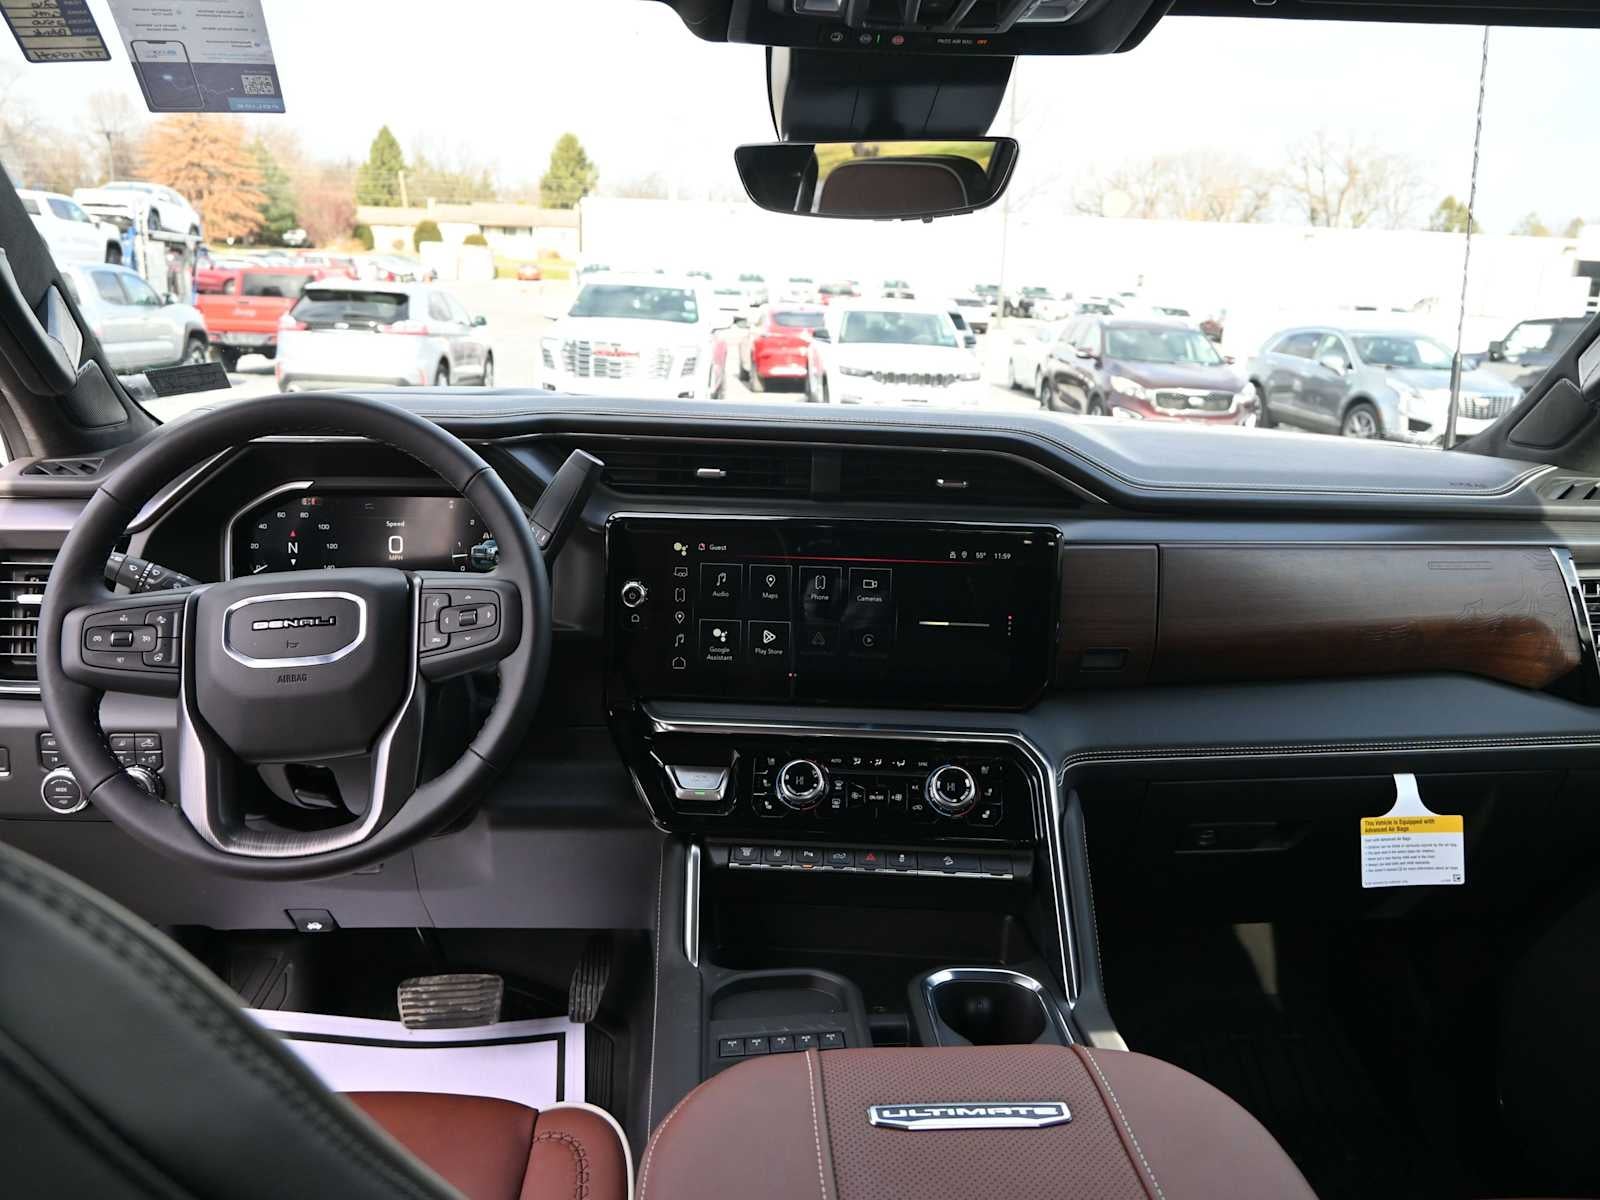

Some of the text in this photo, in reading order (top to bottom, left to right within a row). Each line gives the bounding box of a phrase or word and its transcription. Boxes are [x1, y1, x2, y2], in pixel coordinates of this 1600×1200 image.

[386, 520, 405, 528] Speed
[287, 541, 299, 554] N
[709, 543, 727, 551] Guest
[712, 590, 730, 598] Audio
[762, 592, 779, 600] Maps
[856, 595, 883, 603] Cameras
[252, 616, 336, 631] DENALI
[709, 646, 731, 654] Google
[755, 648, 767, 656] Play
[706, 654, 733, 662] Assistant
[277, 673, 308, 684] AIRBAG
[882, 1106, 1058, 1118] ULTIMATE
